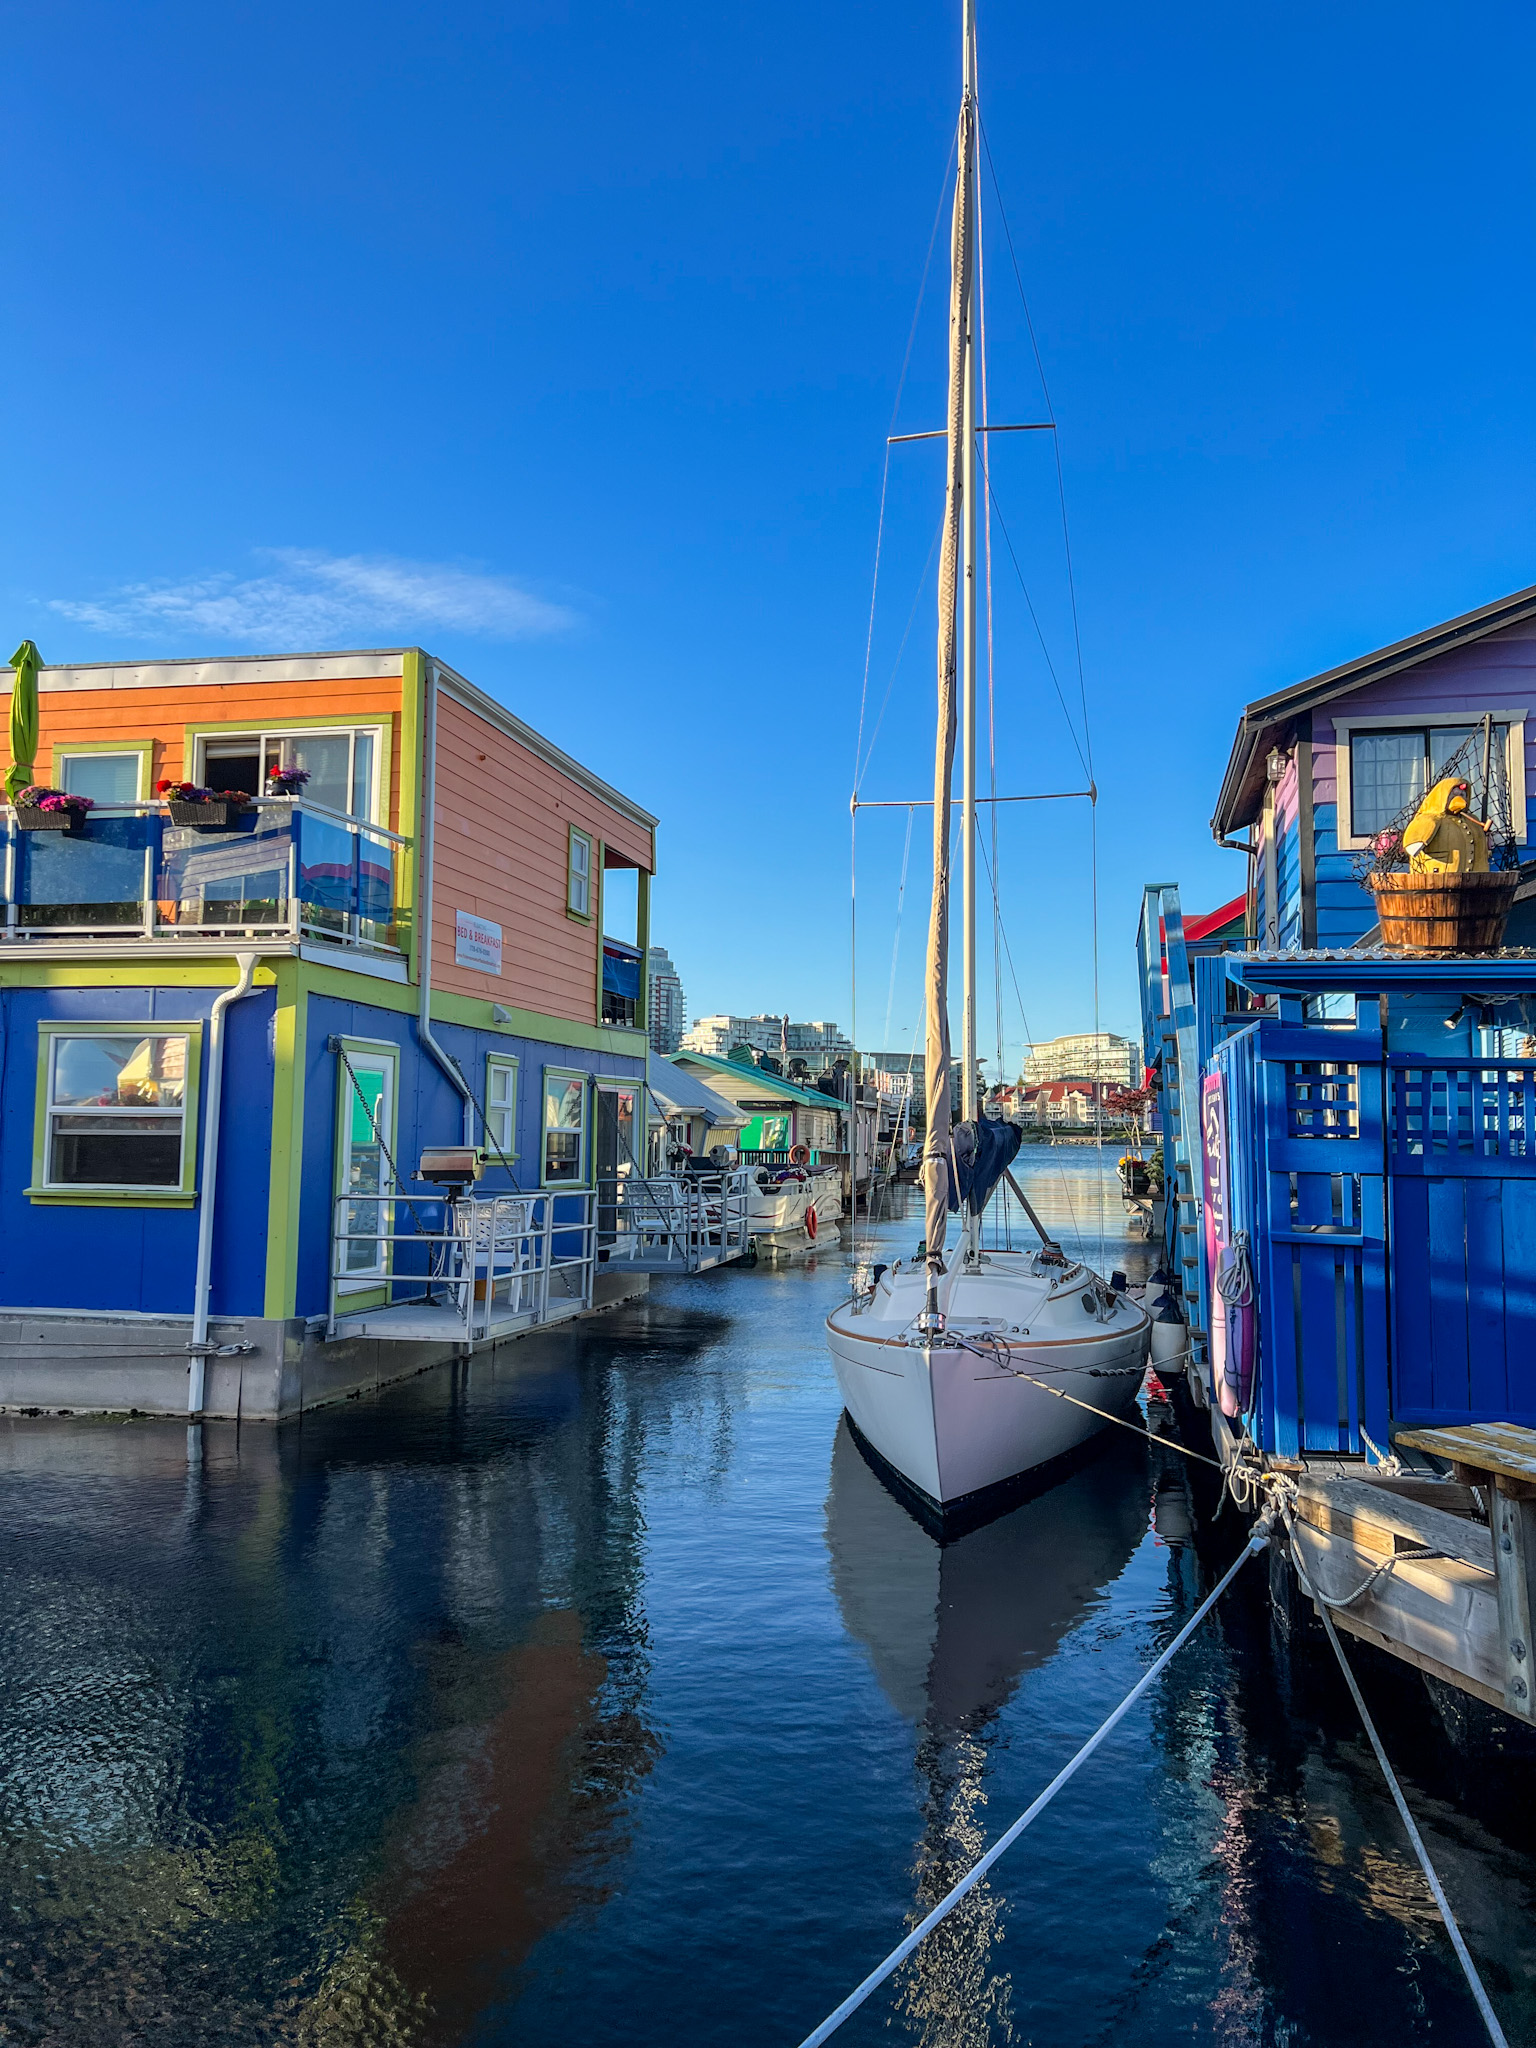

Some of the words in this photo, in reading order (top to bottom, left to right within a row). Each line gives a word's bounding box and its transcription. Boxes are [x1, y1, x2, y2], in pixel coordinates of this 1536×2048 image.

[457, 925, 468, 939] BED
[468, 929, 474, 941] &
[474, 931, 501, 949] BREAKFAST
